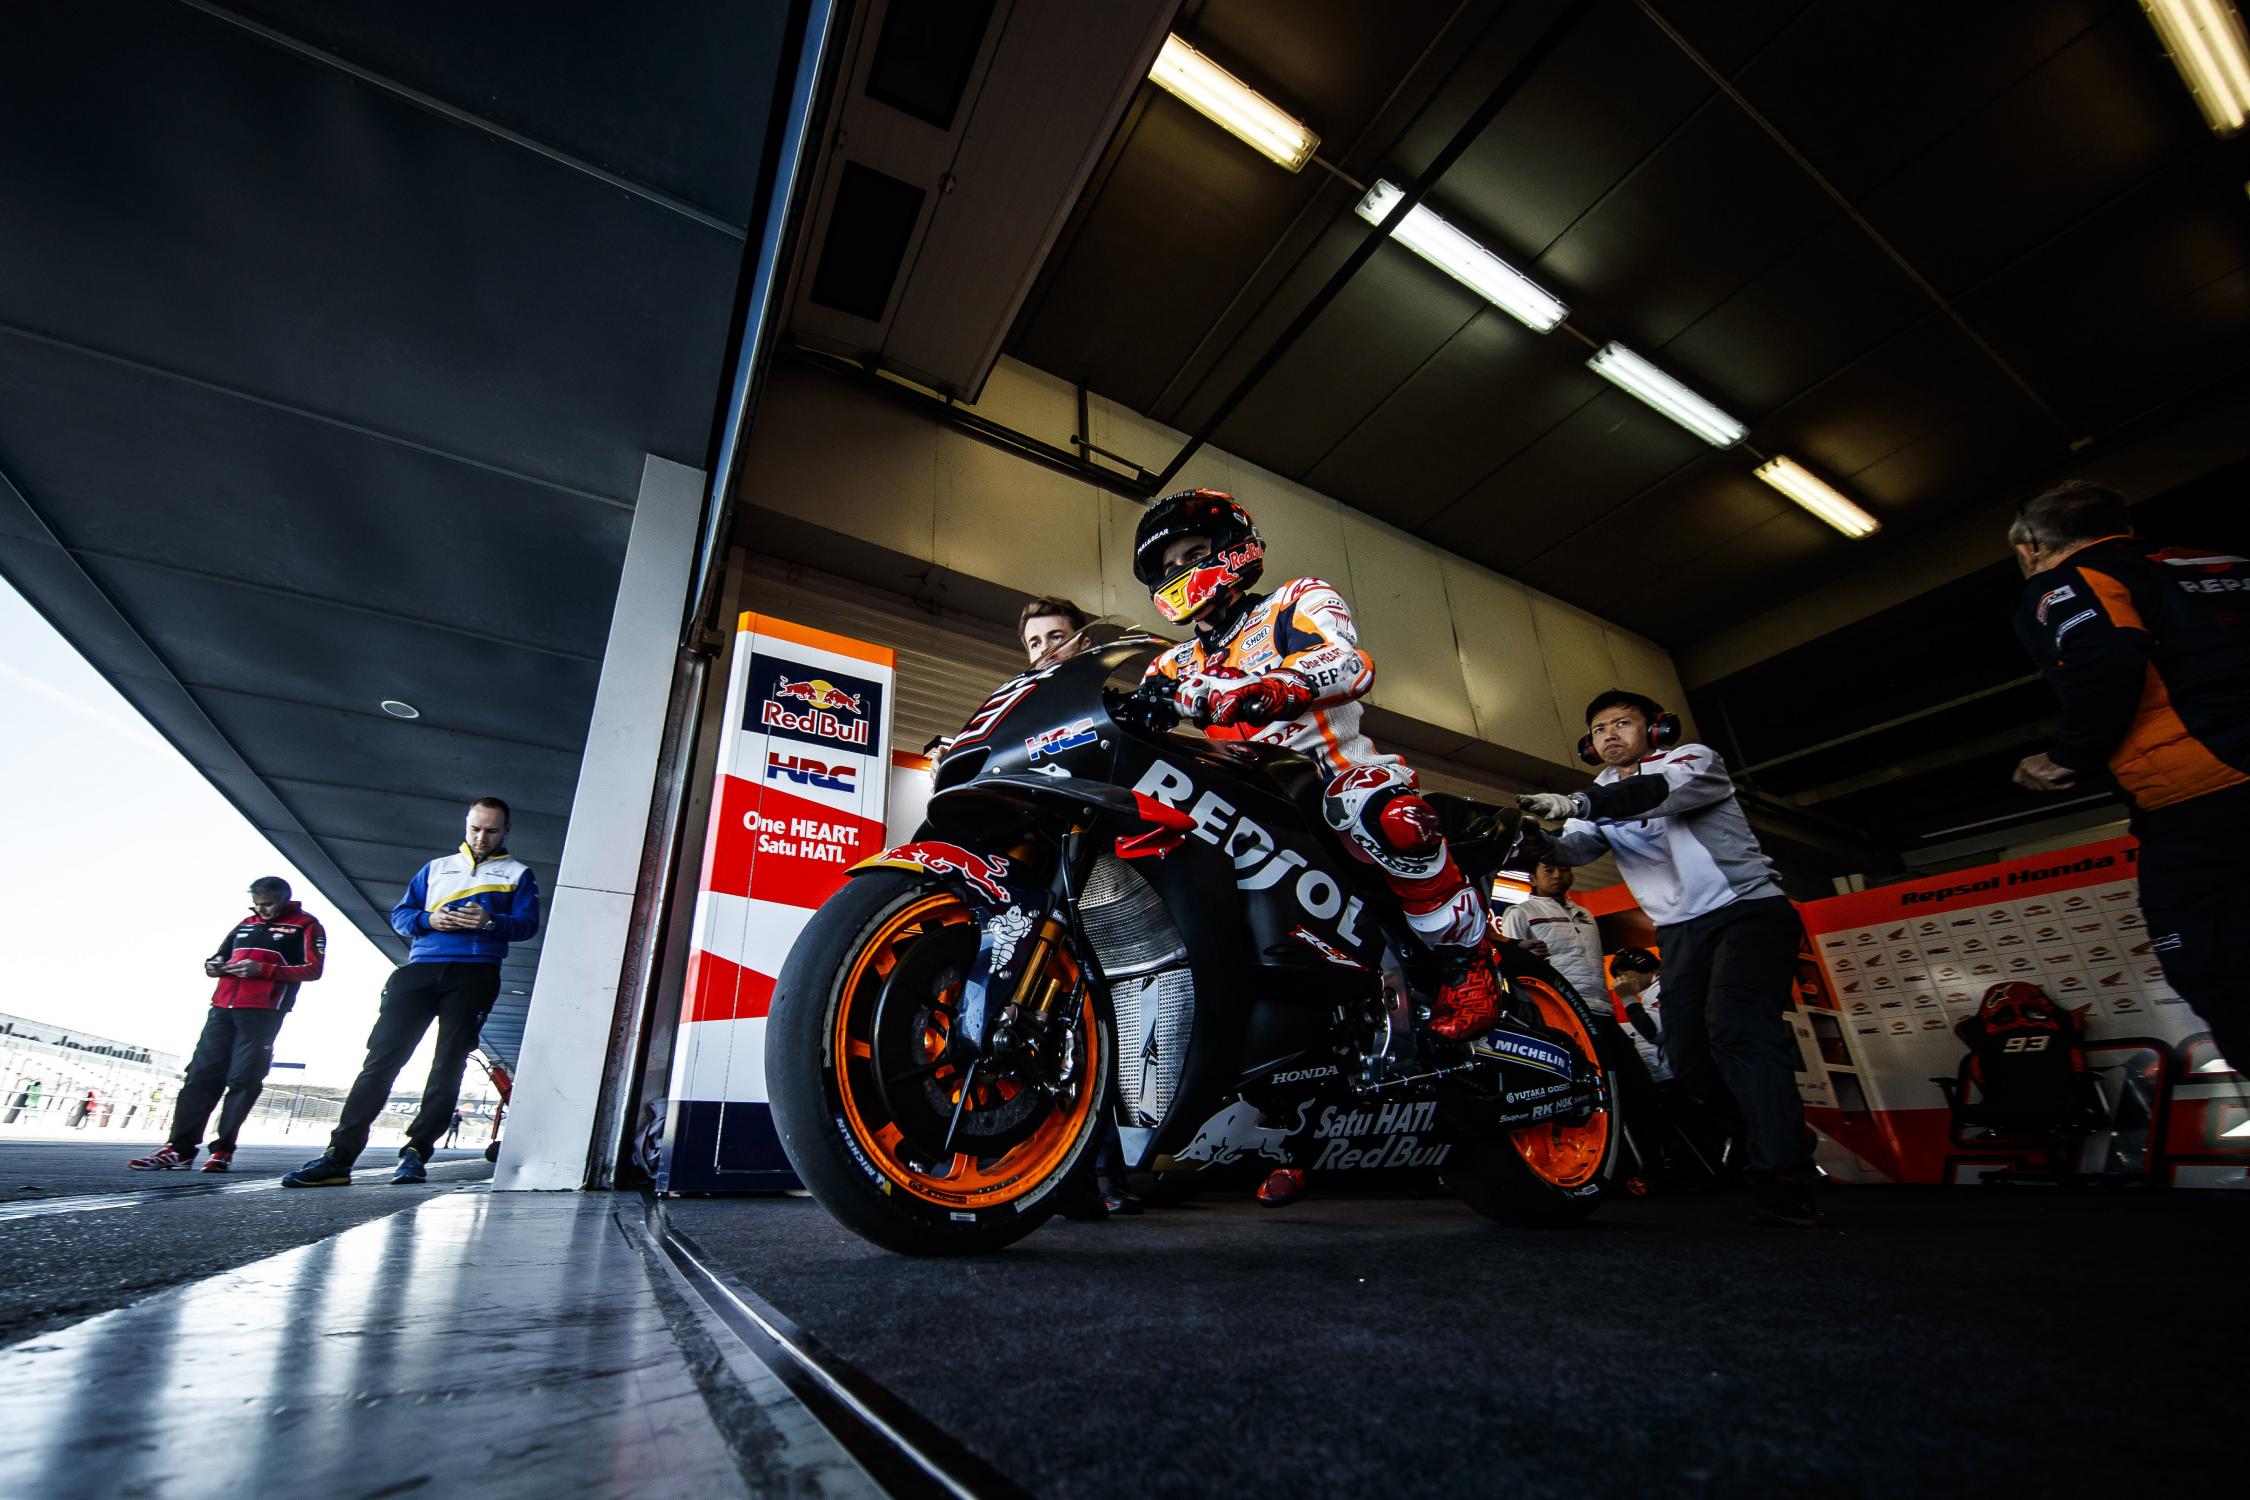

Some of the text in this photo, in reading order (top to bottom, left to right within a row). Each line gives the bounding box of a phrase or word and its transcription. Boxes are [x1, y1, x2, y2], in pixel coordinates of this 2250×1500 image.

[1245, 627, 1269, 649] SHOEI
[1300, 659, 1320, 671] One
[761, 700, 869, 746] Red Bull
[1025, 717, 1098, 761] HRC
[767, 751, 857, 793] HRC
[743, 811, 860, 847] One HEART.
[758, 834, 847, 864] Satu HATI.
[1132, 759, 1363, 947] REPSOL
[1902, 877, 2000, 906] Repsol
[2008, 855, 2116, 886] Honda
[1495, 1039, 1565, 1068] MICHELIN
[2003, 1035, 2050, 1053] 93
[1271, 1065, 1340, 1085] HONDA
[1514, 1087, 1546, 1101] YUTAKA
[1532, 1103, 1554, 1118] RK
[1313, 1101, 1438, 1139] Satu HATI.
[836, 1117, 876, 1177] MICHELIN
[1311, 1134, 1452, 1170] Red Bull
